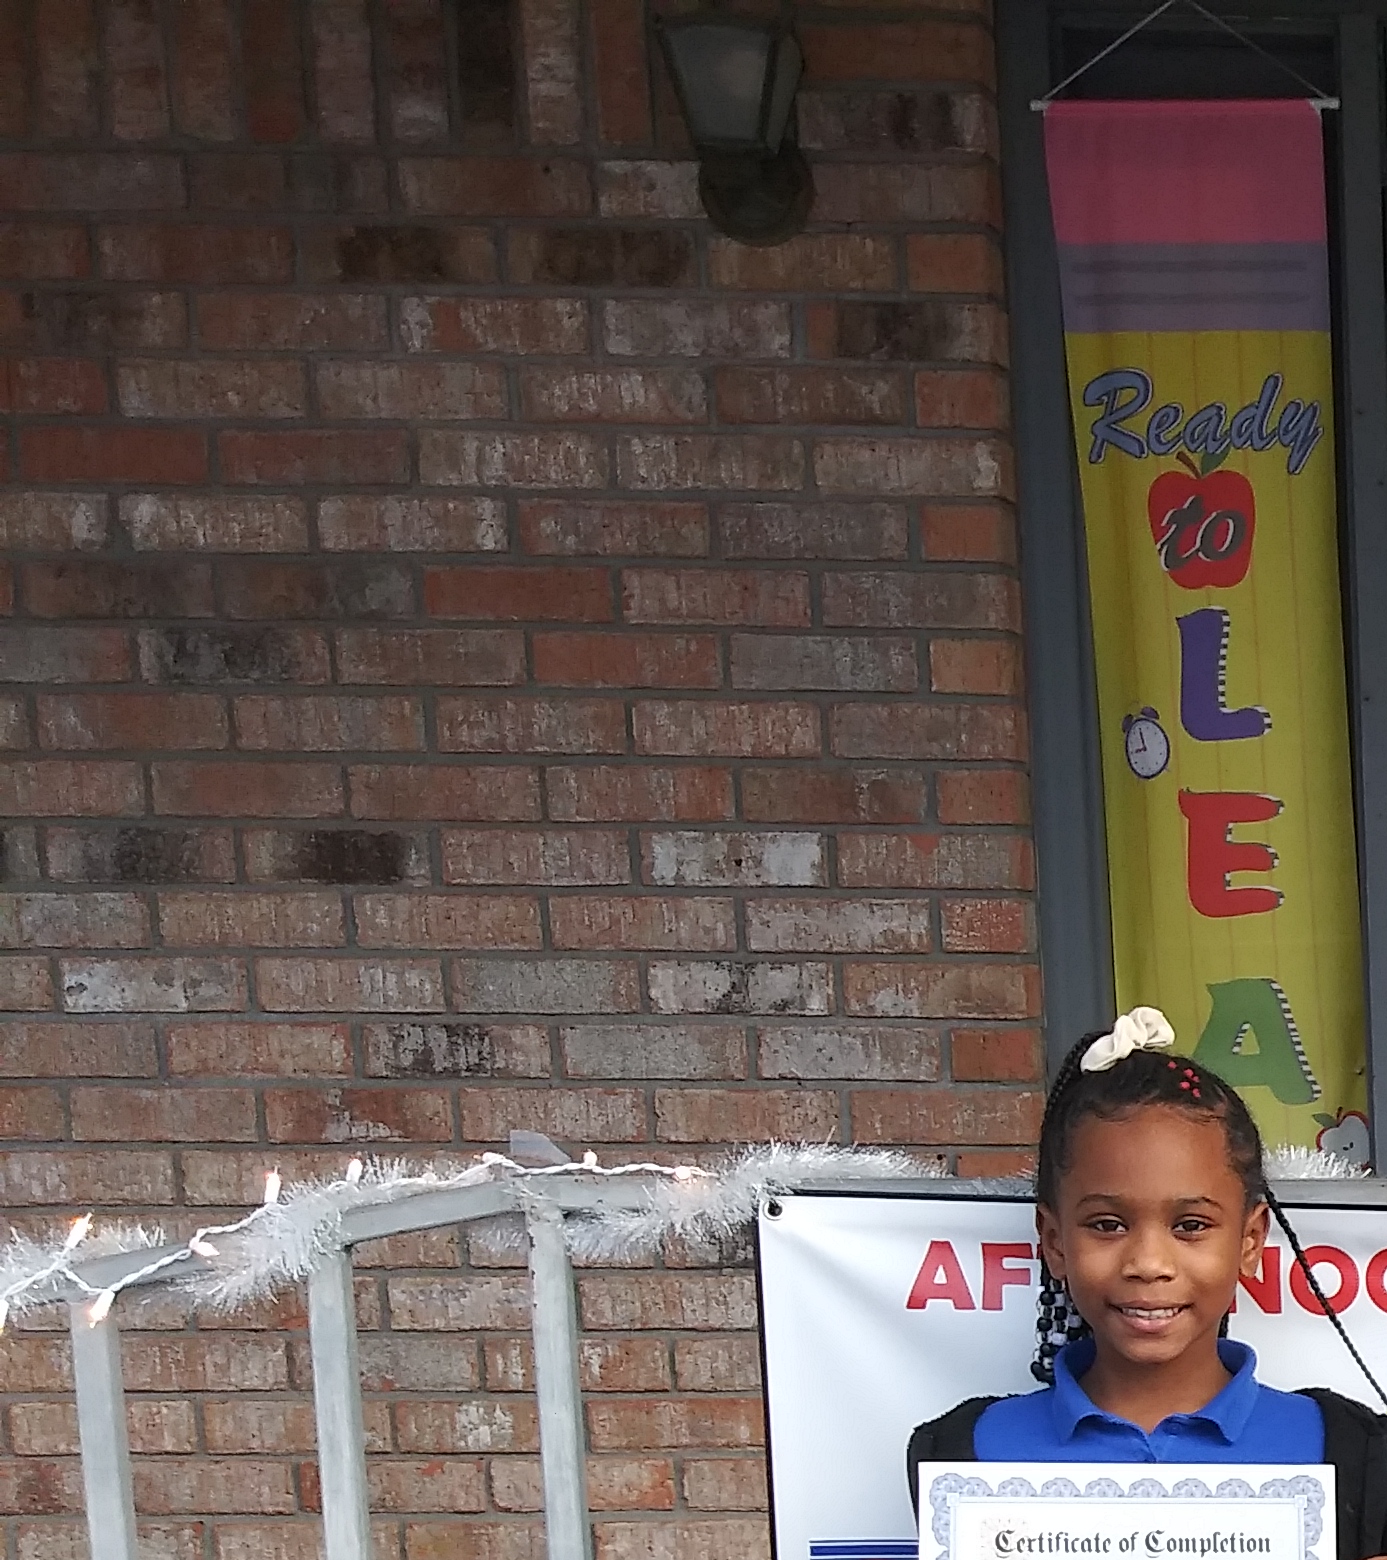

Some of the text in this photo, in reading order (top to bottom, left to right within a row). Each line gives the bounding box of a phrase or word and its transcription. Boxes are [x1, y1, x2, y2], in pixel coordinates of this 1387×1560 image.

[1082, 367, 1324, 475] Ready
[1156, 495, 1247, 571] to
[995, 1529, 1271, 1558] Certificate of Completion
